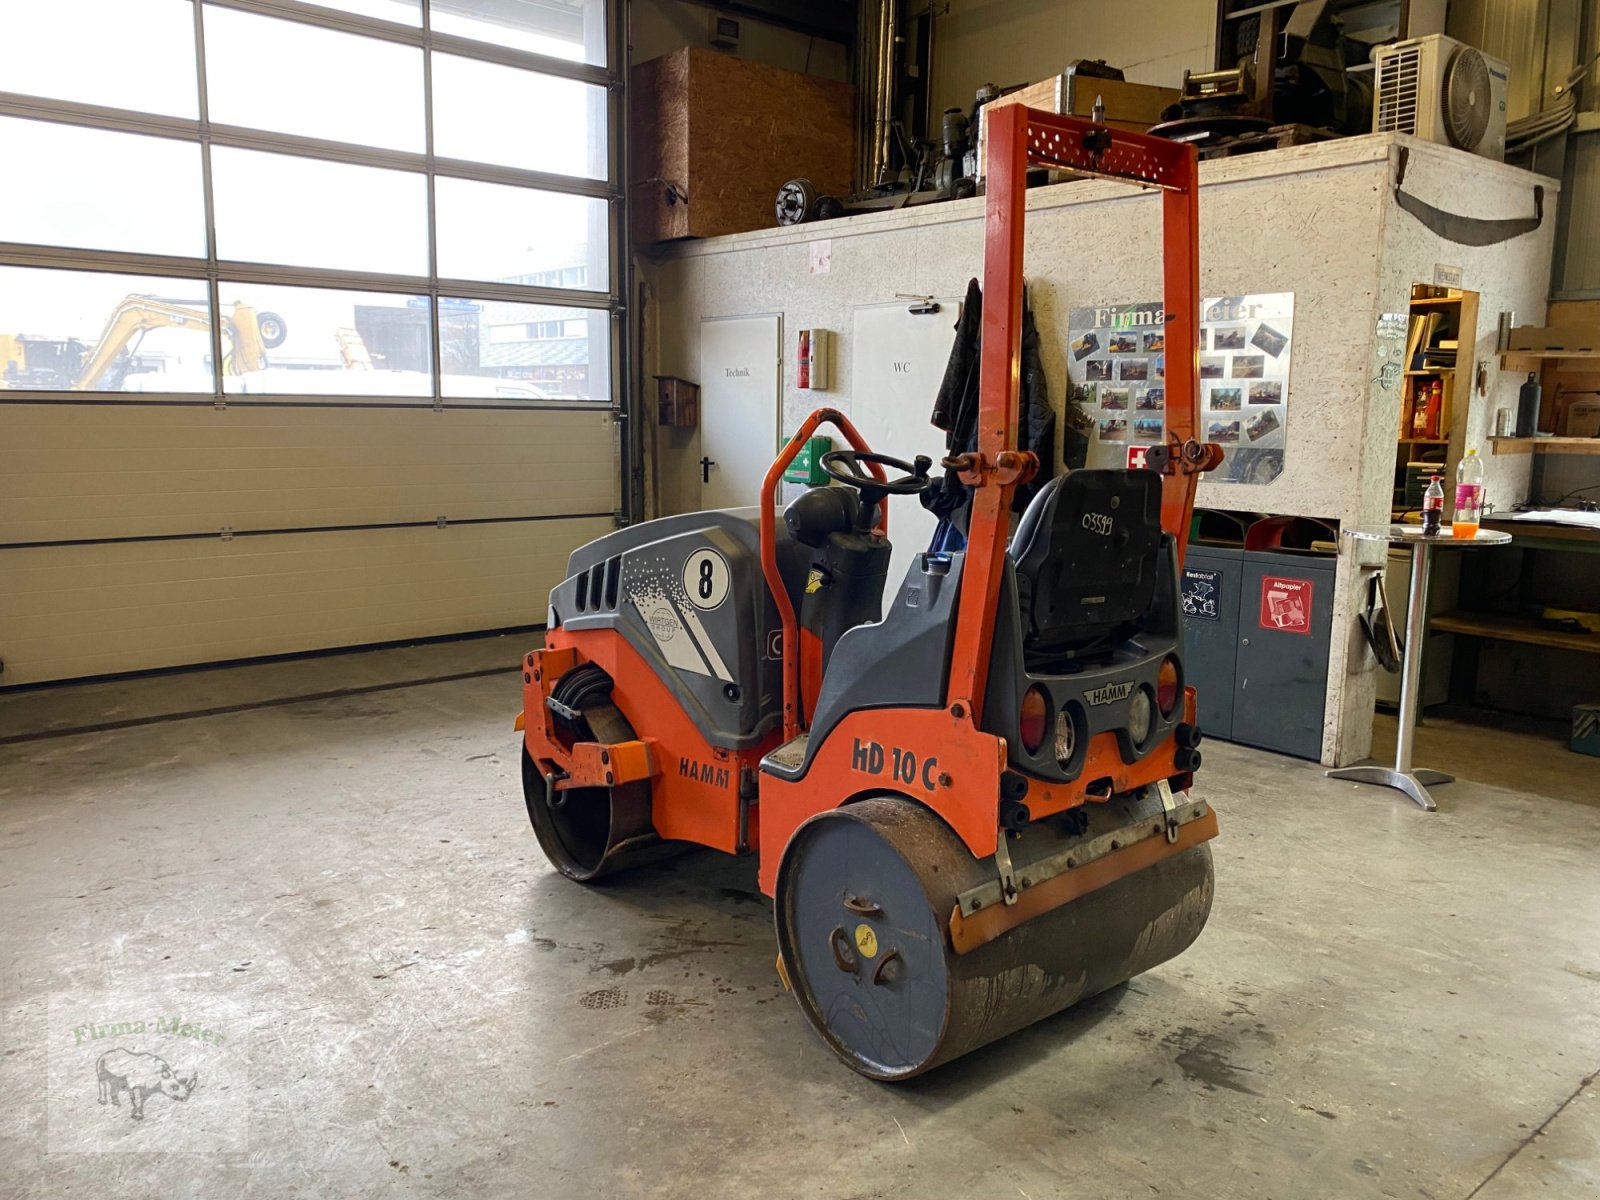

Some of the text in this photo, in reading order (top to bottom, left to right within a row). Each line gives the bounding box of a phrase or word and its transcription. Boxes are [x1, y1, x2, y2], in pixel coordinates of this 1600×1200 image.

[1094, 299, 1262, 328] Firma eier
[725, 367, 750, 377] Technik
[894, 362, 911, 373] WC
[1082, 512, 1113, 535] 03599
[698, 558, 713, 599] 8
[1186, 571, 1214, 581] Restabfall
[1273, 581, 1301, 591] Altpapier
[649, 616, 679, 628] WIRTGEN
[1093, 684, 1127, 704] HAMM
[680, 757, 730, 789] HAMM
[851, 738, 938, 791] HD 10 C
